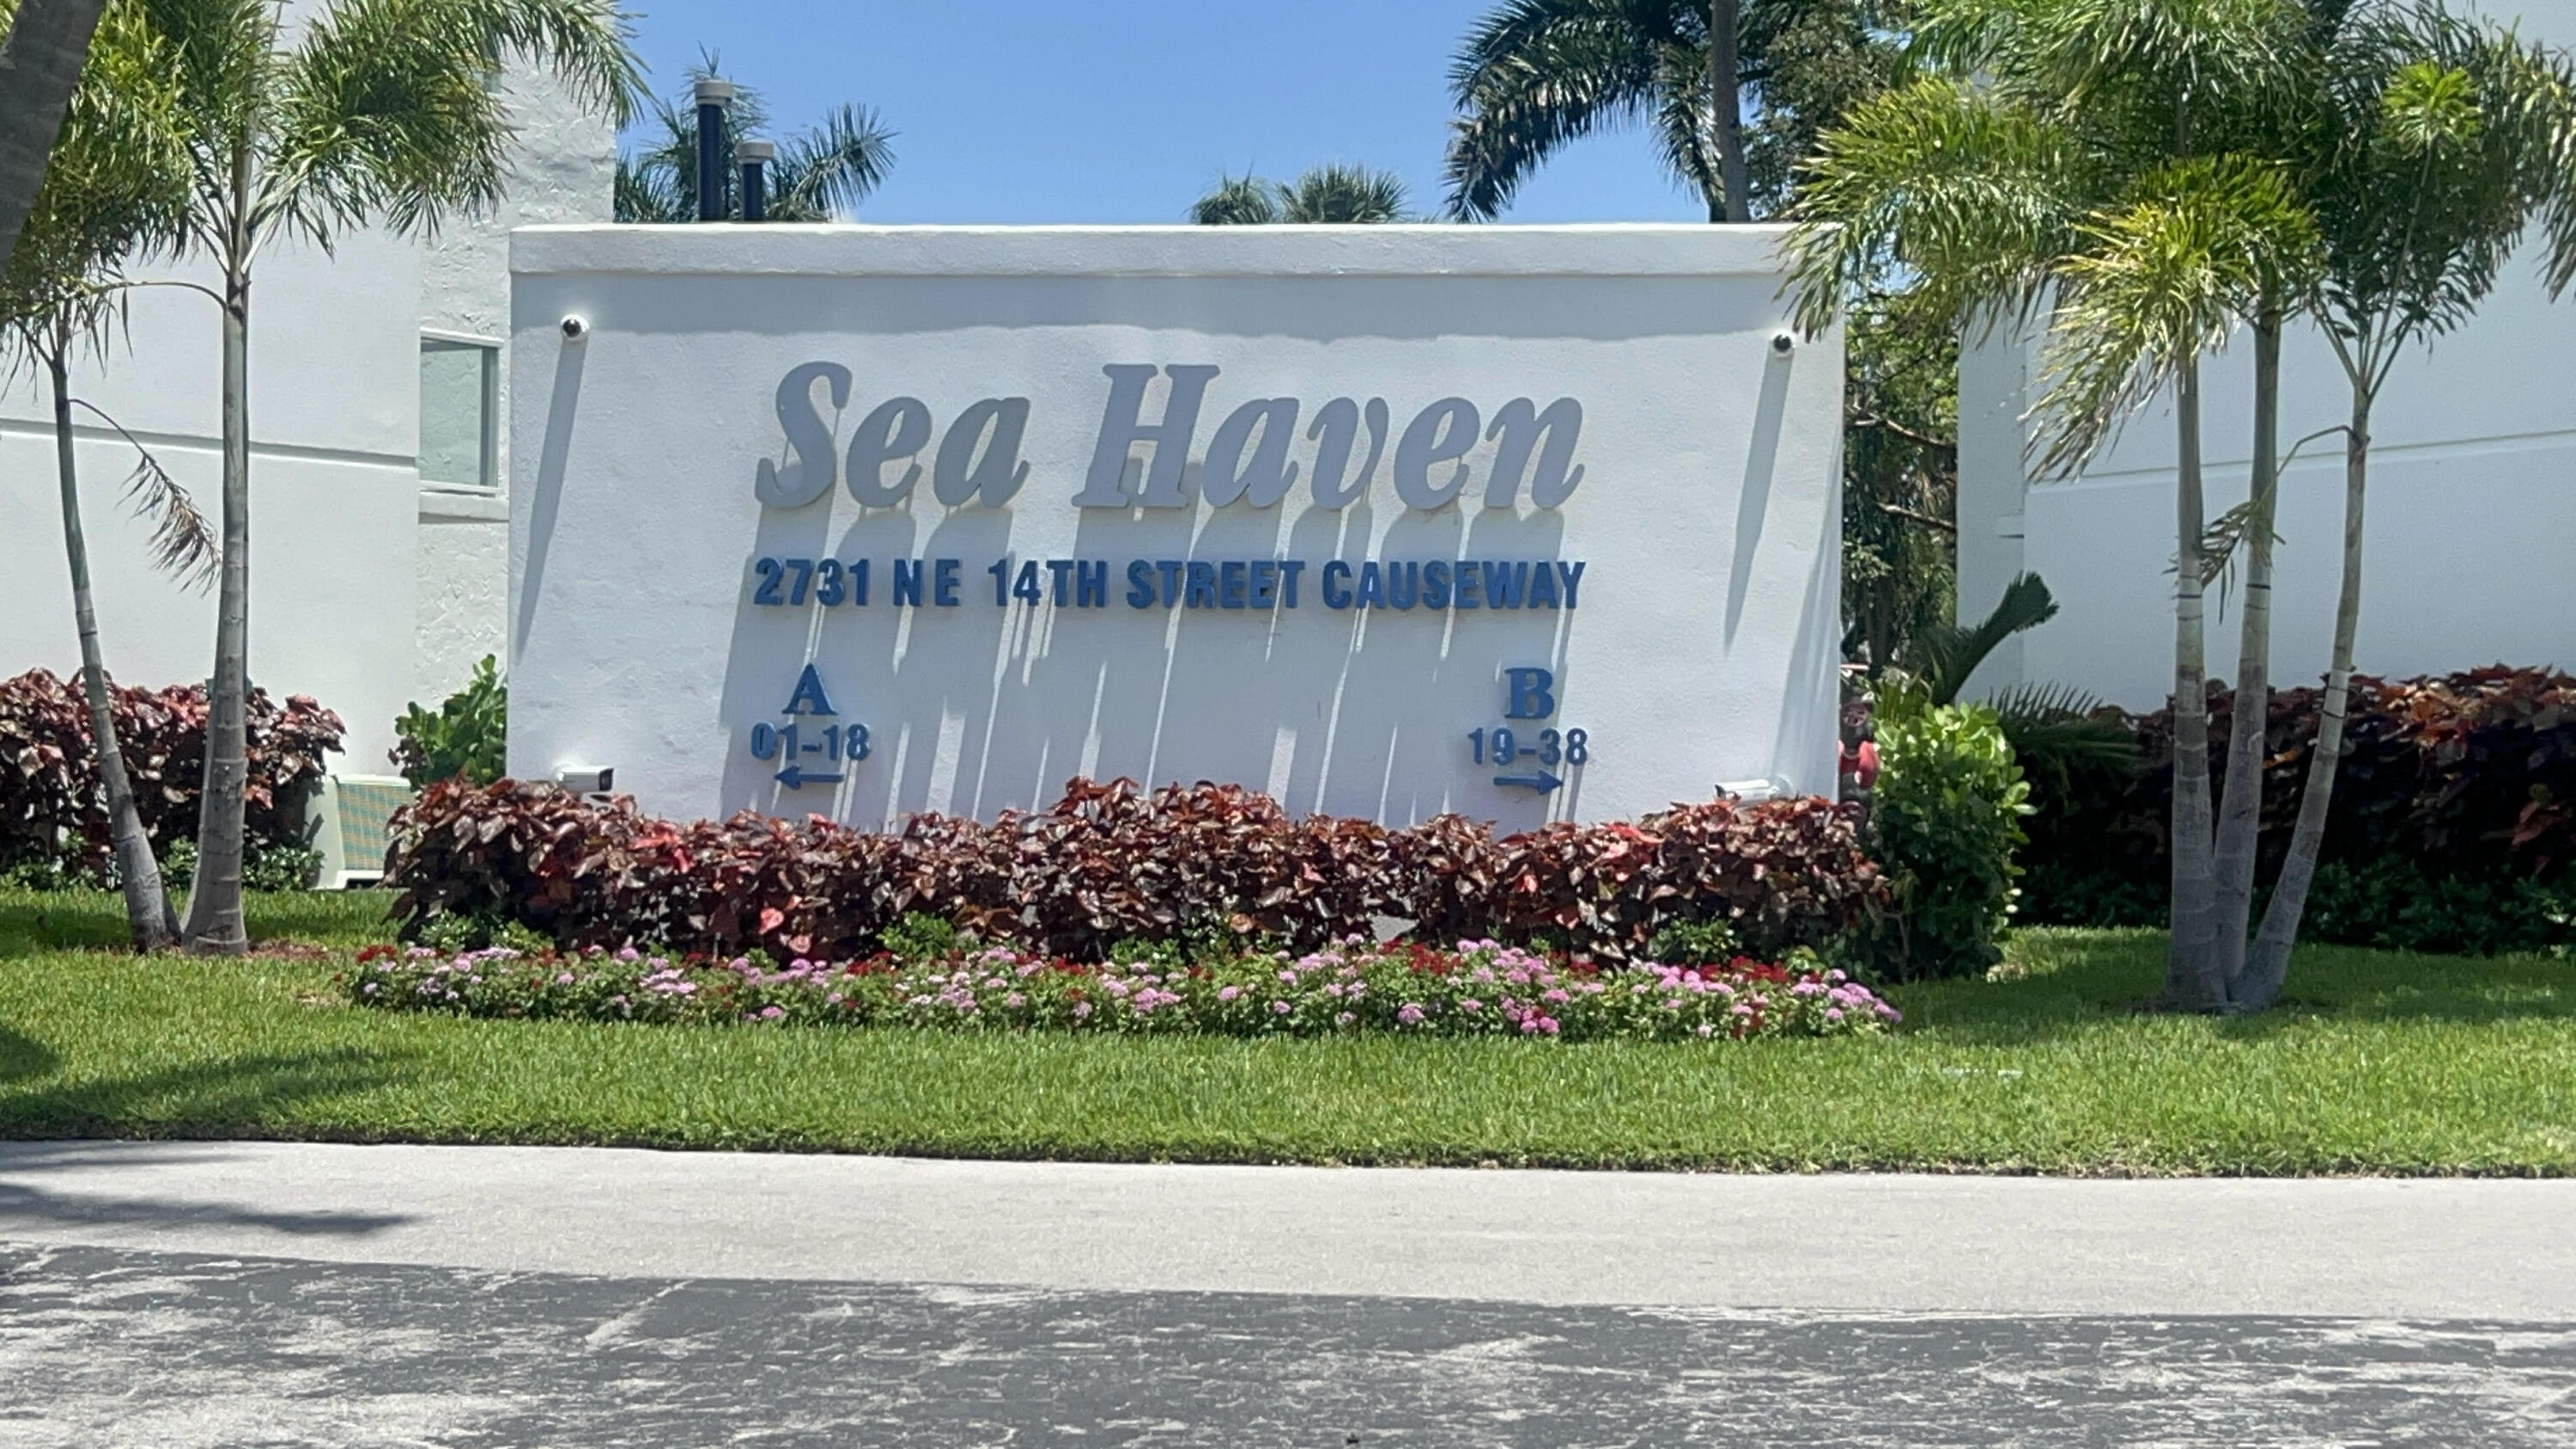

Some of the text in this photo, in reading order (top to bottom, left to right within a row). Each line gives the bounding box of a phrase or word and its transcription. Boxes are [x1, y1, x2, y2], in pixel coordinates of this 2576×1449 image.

[755, 361, 1585, 510] Sea Haven
[753, 557, 870, 606] 2731
[987, 558, 1109, 608] 14TH
[1126, 559, 1305, 609] STREET
[1321, 560, 1586, 610] CAUSEWAY
[781, 663, 838, 715] A
[1504, 666, 1554, 720] B
[750, 721, 871, 762] 01-18
[1467, 727, 1589, 767] 19-38
